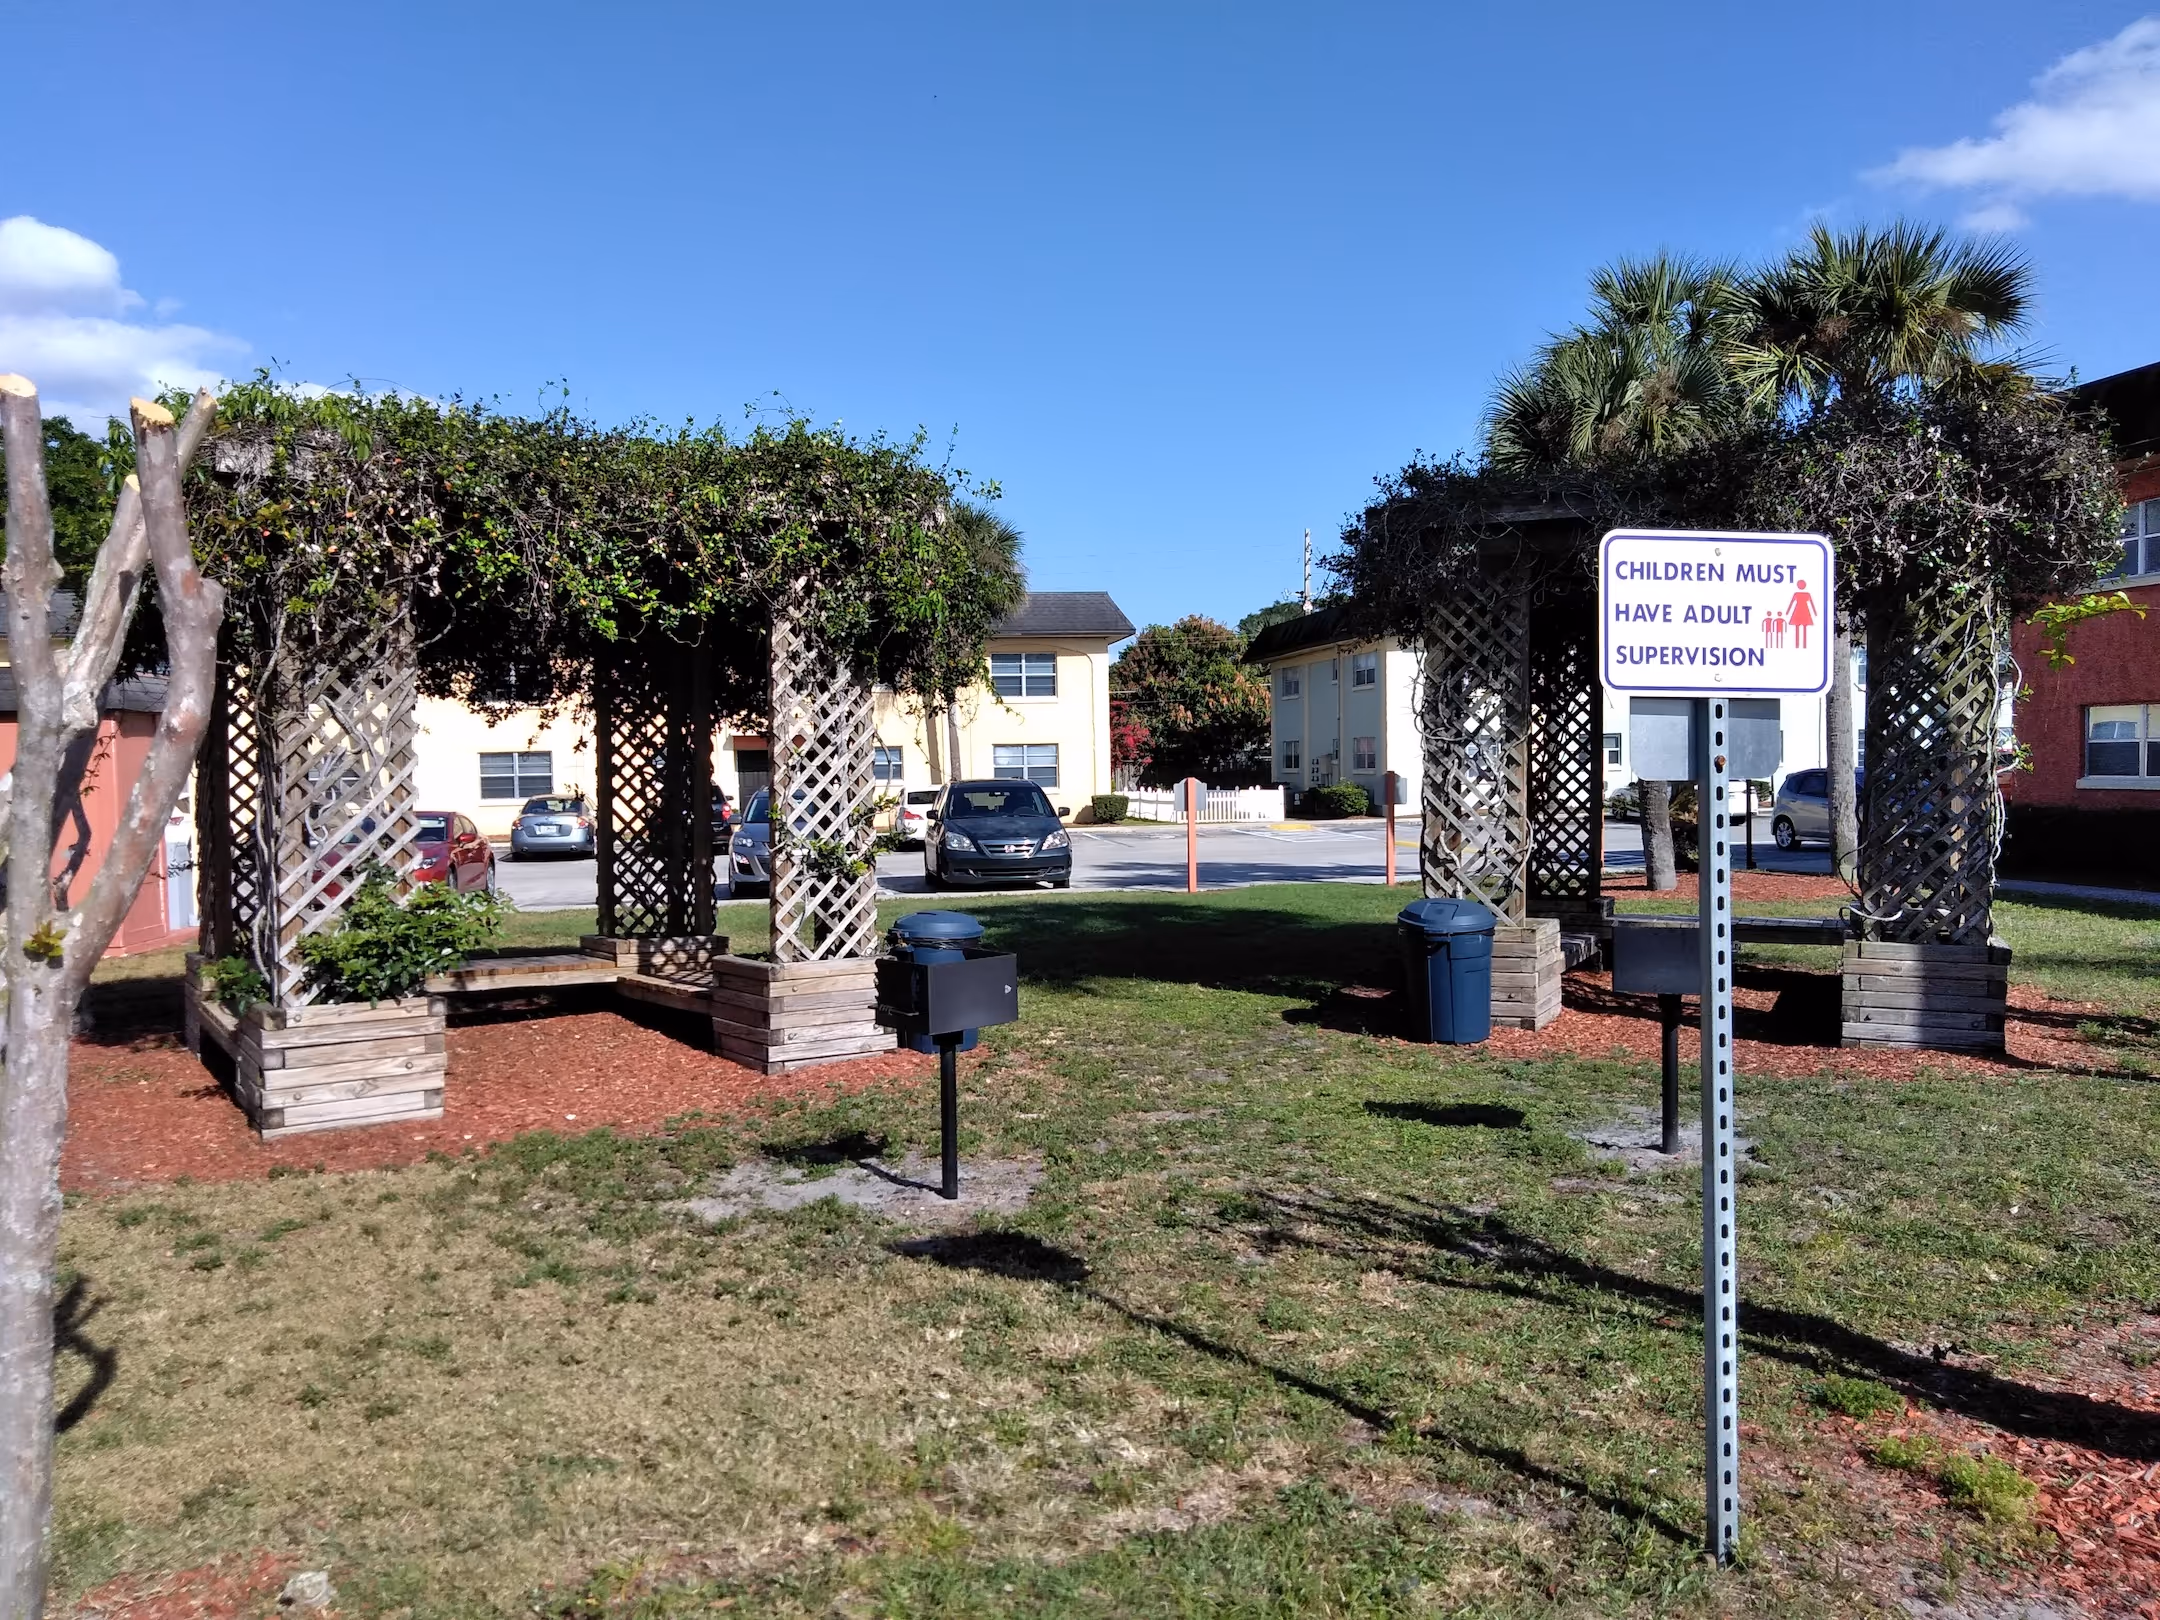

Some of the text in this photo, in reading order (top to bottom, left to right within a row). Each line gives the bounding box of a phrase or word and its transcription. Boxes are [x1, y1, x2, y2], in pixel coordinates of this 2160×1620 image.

[1615, 561, 1797, 584] CHILDREN MUST
[1615, 603, 1752, 625] HAVE ADULT
[1616, 645, 1765, 667] SUPERVISION
